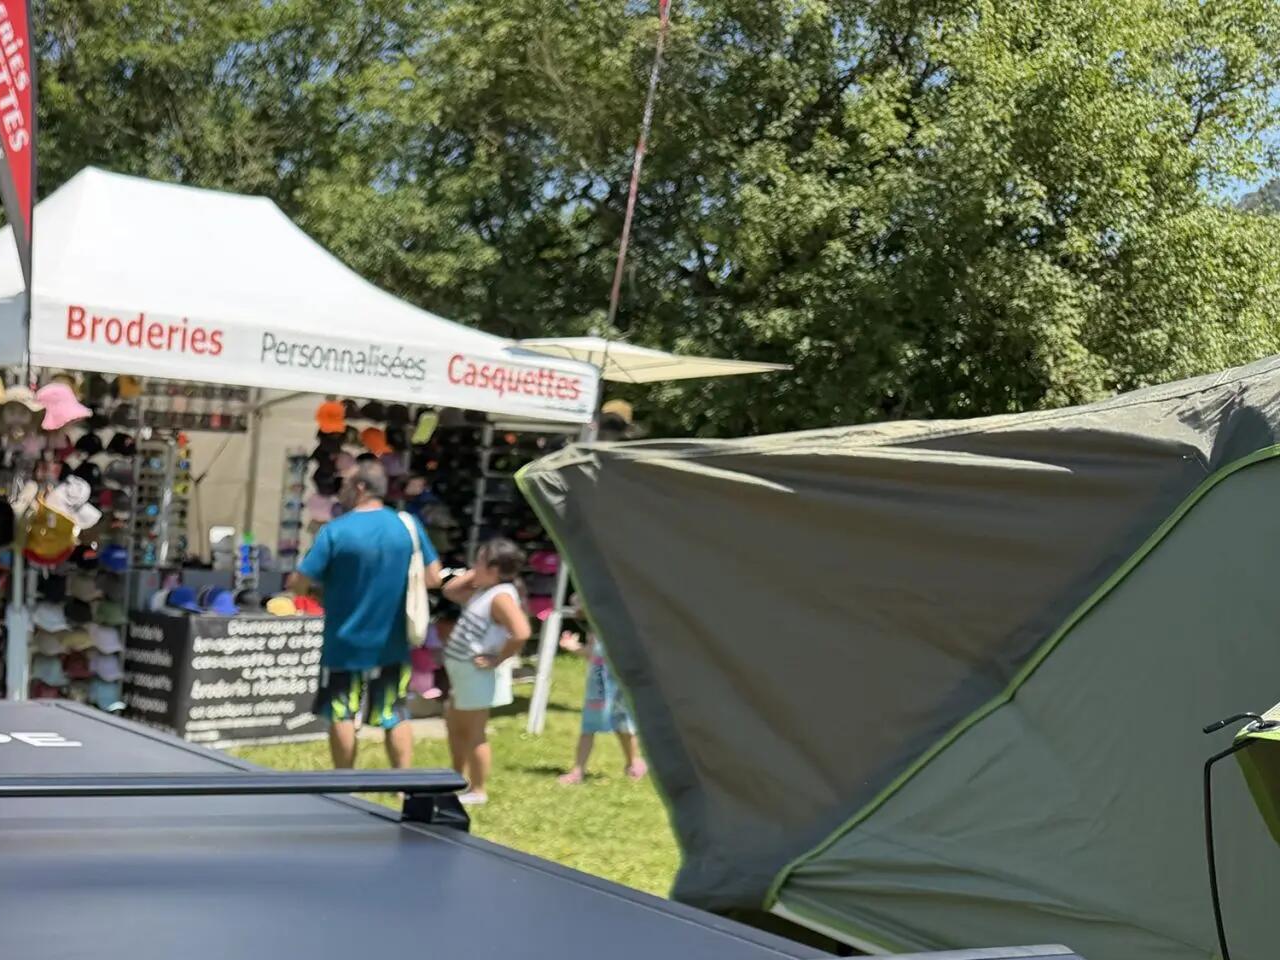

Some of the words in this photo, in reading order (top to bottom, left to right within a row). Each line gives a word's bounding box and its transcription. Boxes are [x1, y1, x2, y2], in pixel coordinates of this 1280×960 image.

[66, 304, 225, 357] Broderies
[260, 331, 427, 381] Personnalisées
[446, 353, 584, 401] Casquettes
